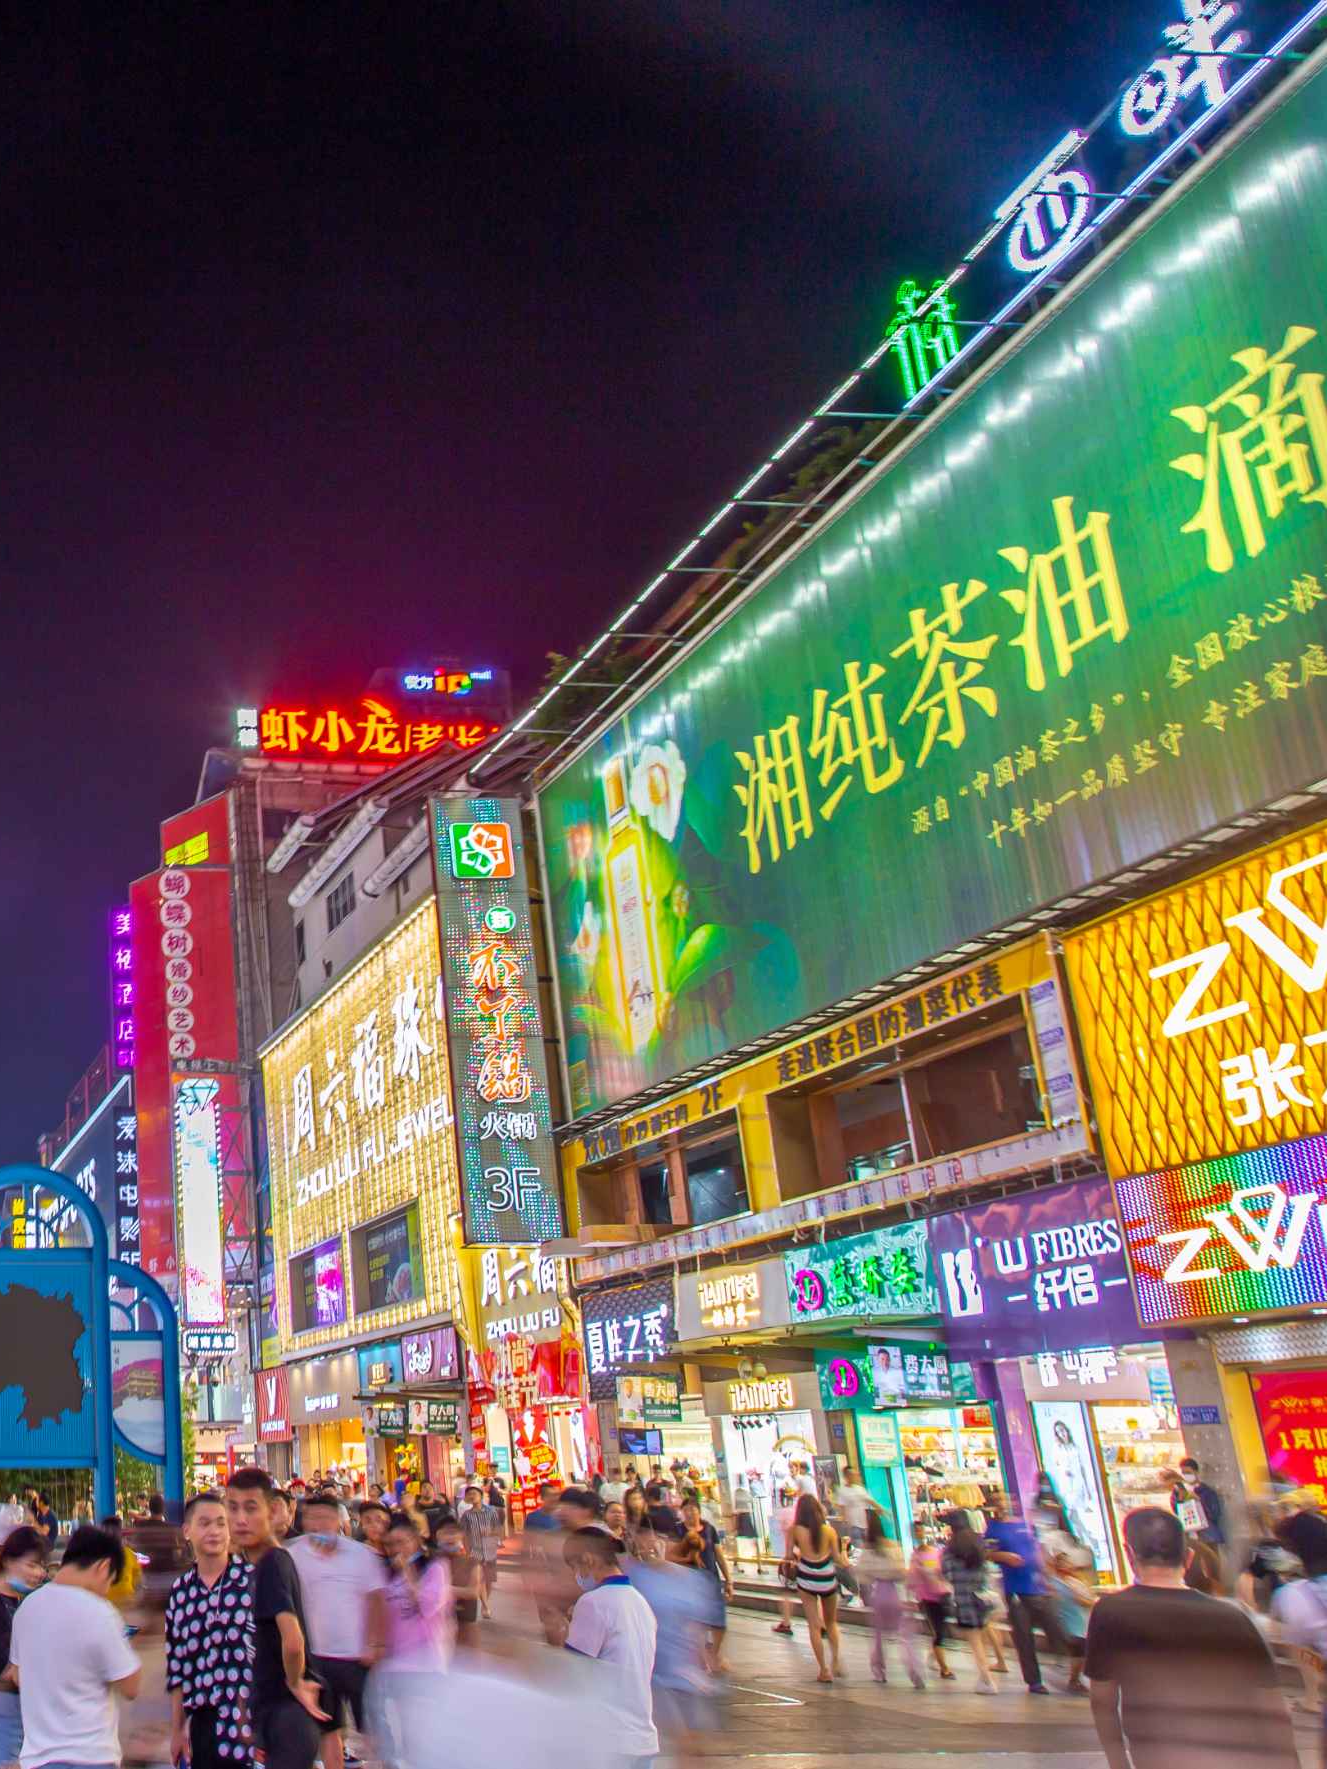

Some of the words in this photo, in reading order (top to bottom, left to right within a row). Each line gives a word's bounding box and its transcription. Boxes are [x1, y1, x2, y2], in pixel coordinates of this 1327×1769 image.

[733, 495, 1129, 874] 湘纯茶油
[291, 973, 444, 1157] 周六福珠
[480, 1111, 538, 1141] 火锅
[296, 1162, 333, 1207] ZHOU
[363, 1130, 385, 1171] FU
[484, 1166, 542, 1213] 3F
[1031, 1218, 1122, 1266] FIBRES
[481, 1248, 557, 1307] 周六福
[1033, 1263, 1100, 1312] 纤侣
